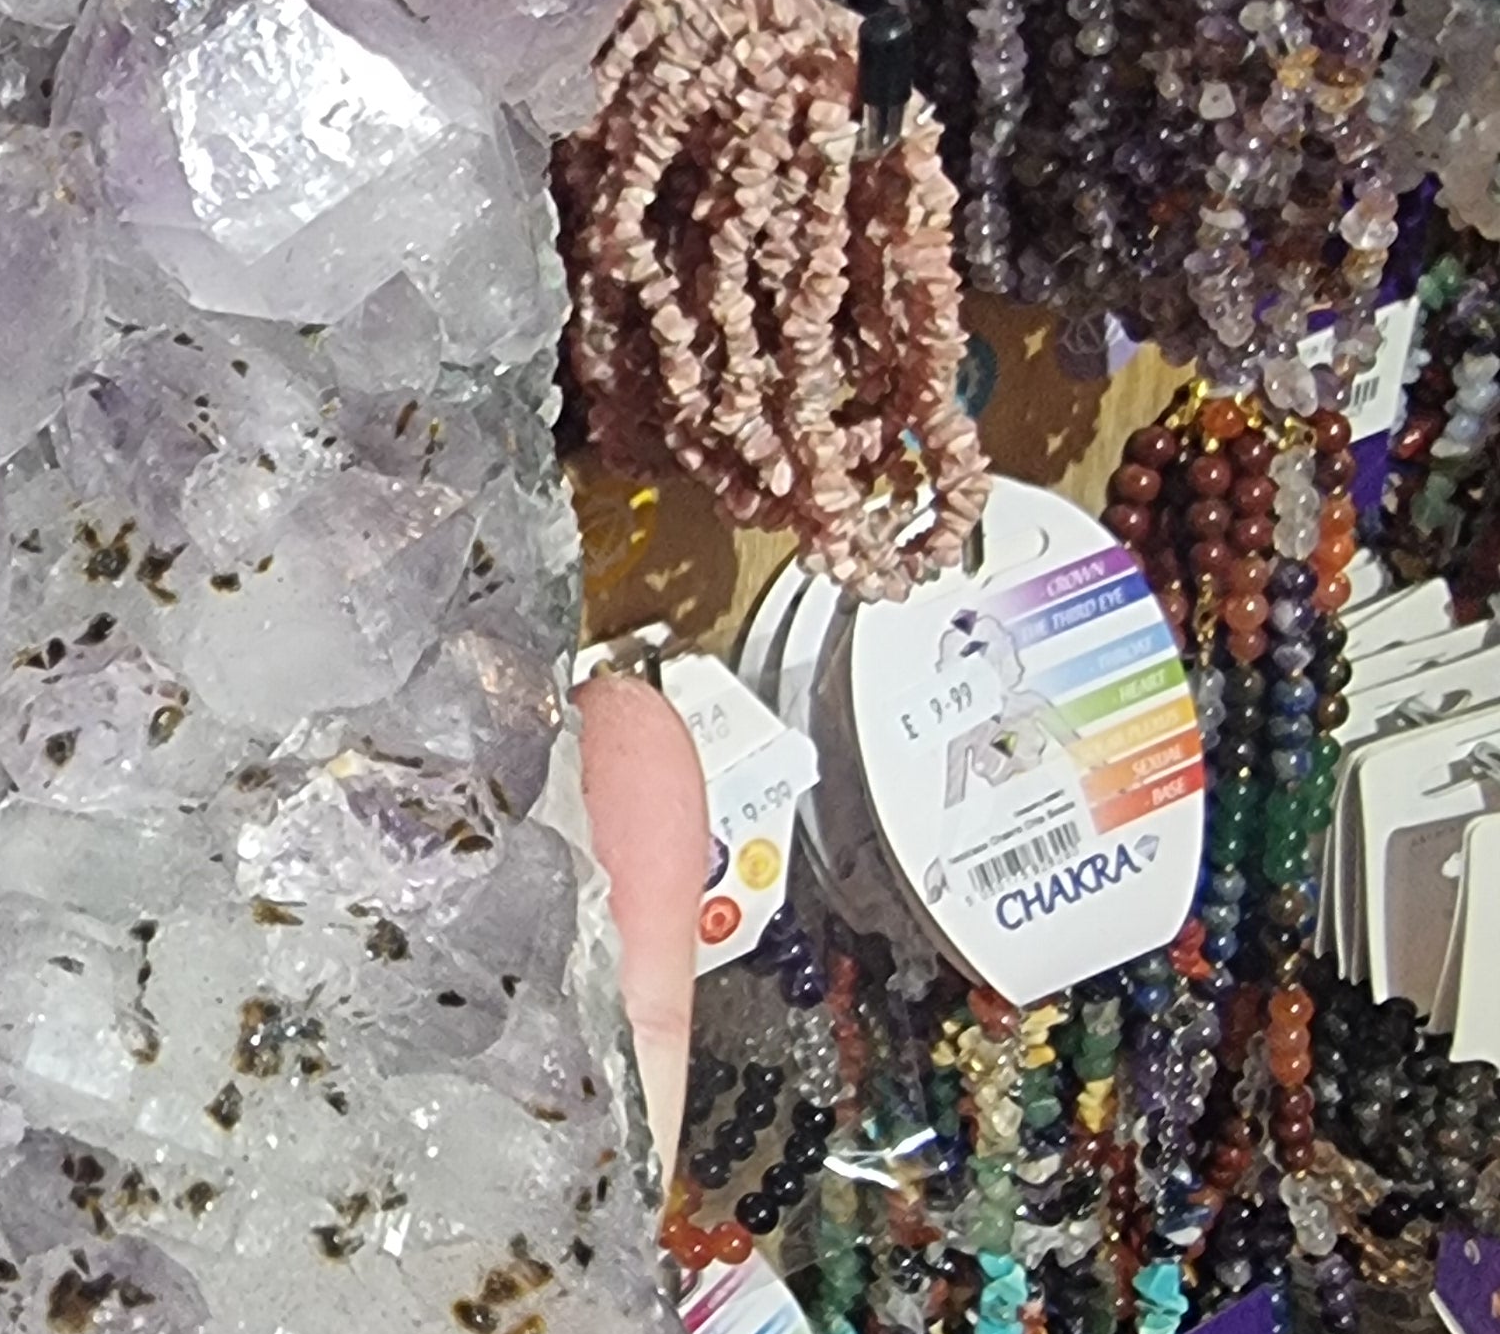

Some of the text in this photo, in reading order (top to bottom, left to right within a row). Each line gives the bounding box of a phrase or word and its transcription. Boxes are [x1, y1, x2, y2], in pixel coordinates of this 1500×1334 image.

[1046, 560, 1105, 597] CROWN
[1099, 586, 1125, 612] EYE
[1118, 670, 1167, 703] HEART
[1152, 777, 1187, 806] BASE
[996, 843, 1142, 930] CHAKRA
